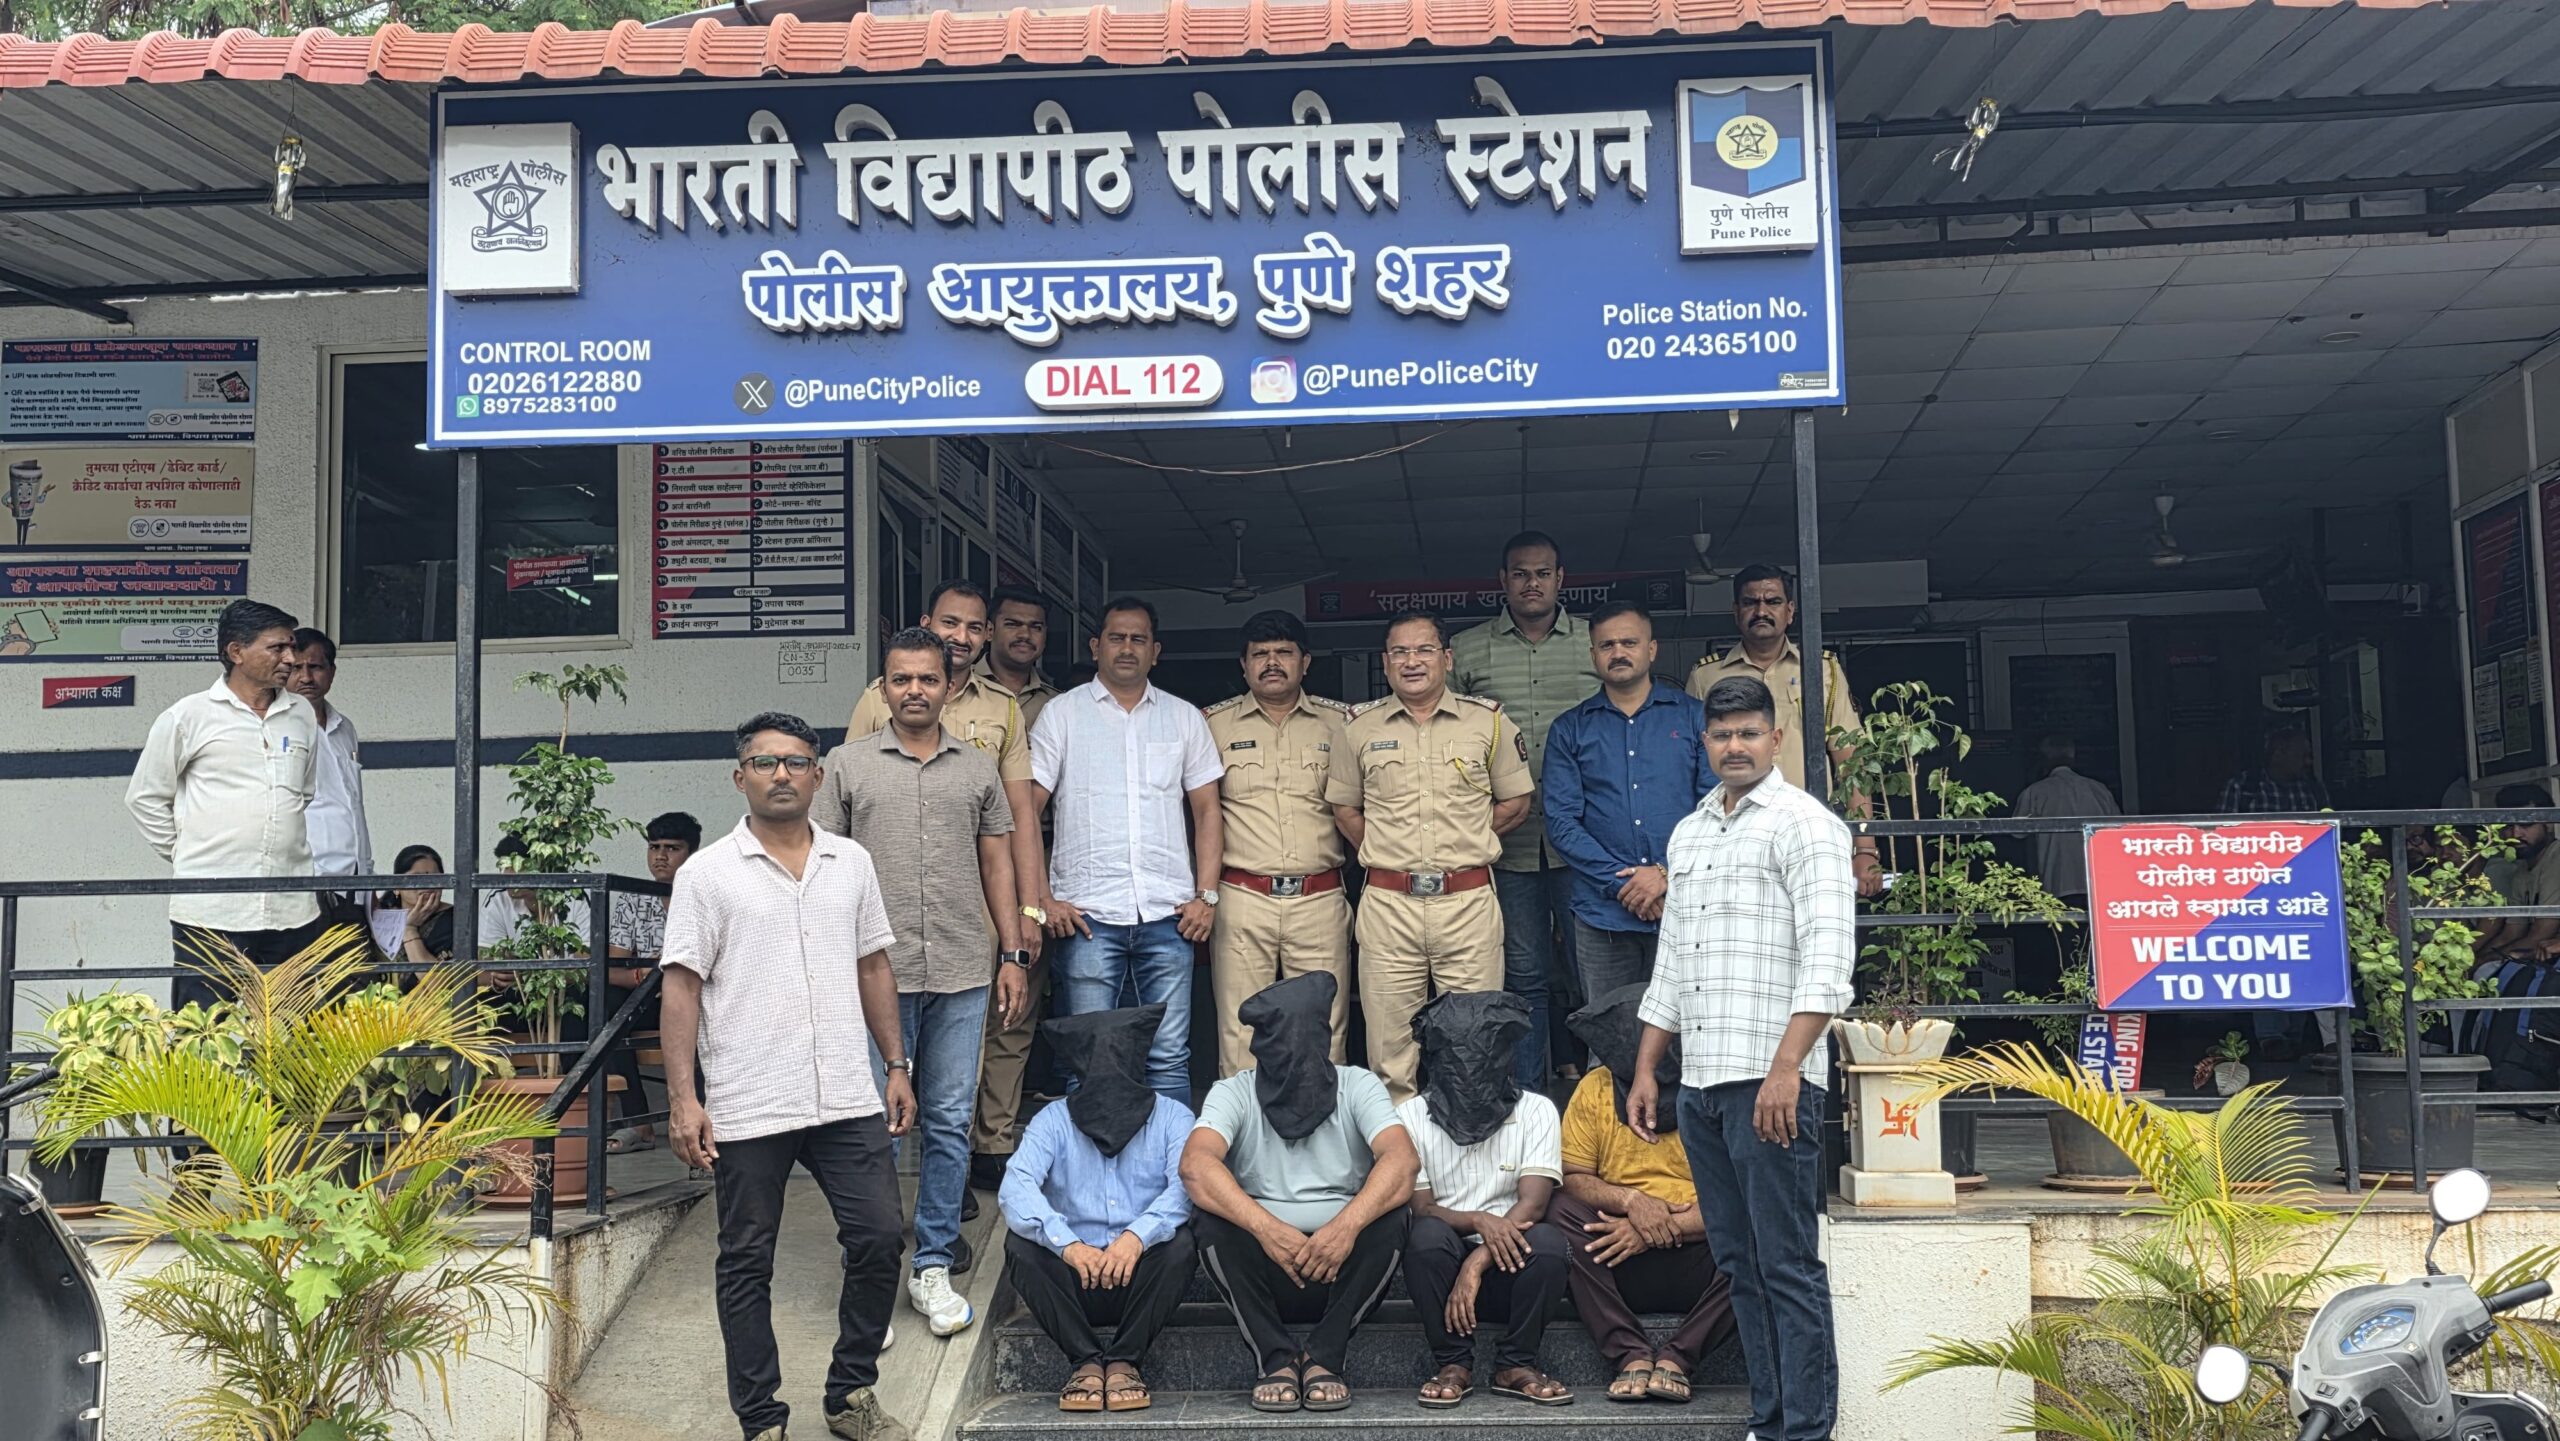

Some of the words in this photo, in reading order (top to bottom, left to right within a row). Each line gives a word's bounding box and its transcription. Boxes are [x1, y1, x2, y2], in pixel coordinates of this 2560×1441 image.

[597, 109, 804, 232] भारती
[824, 100, 1133, 226] विद्यापीठ
[1158, 90, 1404, 216] पोलीस
[1435, 76, 1652, 211] स्टेशन
[449, 164, 500, 187] महाराष्ट्र
[520, 160, 568, 186] पोलीस
[1710, 203, 1733, 226] पुणे
[1740, 202, 1790, 220] पोलीस
[1711, 227, 1745, 240] Pune
[1750, 225, 1791, 238] Police
[742, 249, 905, 331] पोलीस
[1254, 231, 1354, 338] पुणे
[1376, 244, 1510, 319] शहर
[1603, 302, 1673, 326] Police
[1682, 299, 1762, 323] Station
[1770, 297, 1808, 319] No.
[460, 341, 573, 365] CONTROL
[580, 340, 651, 363] ROOM
[1607, 336, 1655, 359] 020
[1665, 330, 1797, 358] 24365100
[468, 370, 641, 394] 02026122880
[1046, 364, 1131, 397] DIAL
[1143, 363, 1201, 395] 112
[1304, 359, 1538, 395] @PunePoliceCity
[785, 376, 981, 406] @PuneCityPolice
[483, 396, 617, 414] 8975283100
[86, 463, 119, 477] तुमच्या
[123, 459, 156, 473] एटीएम
[73, 479, 101, 492] क्रेडिट
[189, 477, 241, 491] कोणालाही
[154, 499, 177, 509] नका
[787, 666, 816, 676] 0035
[55, 687, 97, 701] अभ्यागत
[101, 685, 122, 699] कक्ष
[2121, 834, 2193, 856] भारती
[2200, 831, 2303, 855] विद्यापीठ
[2136, 864, 2216, 887] पोलीस
[2223, 861, 2292, 886] ठाणेत
[2107, 894, 2179, 919] आपले
[2186, 897, 2268, 918] स्वागत
[2276, 892, 2329, 917] आहे
[2131, 934, 2311, 963] WELCOME
[2155, 974, 2204, 1000] TO
[2212, 973, 2291, 1000] YOU
